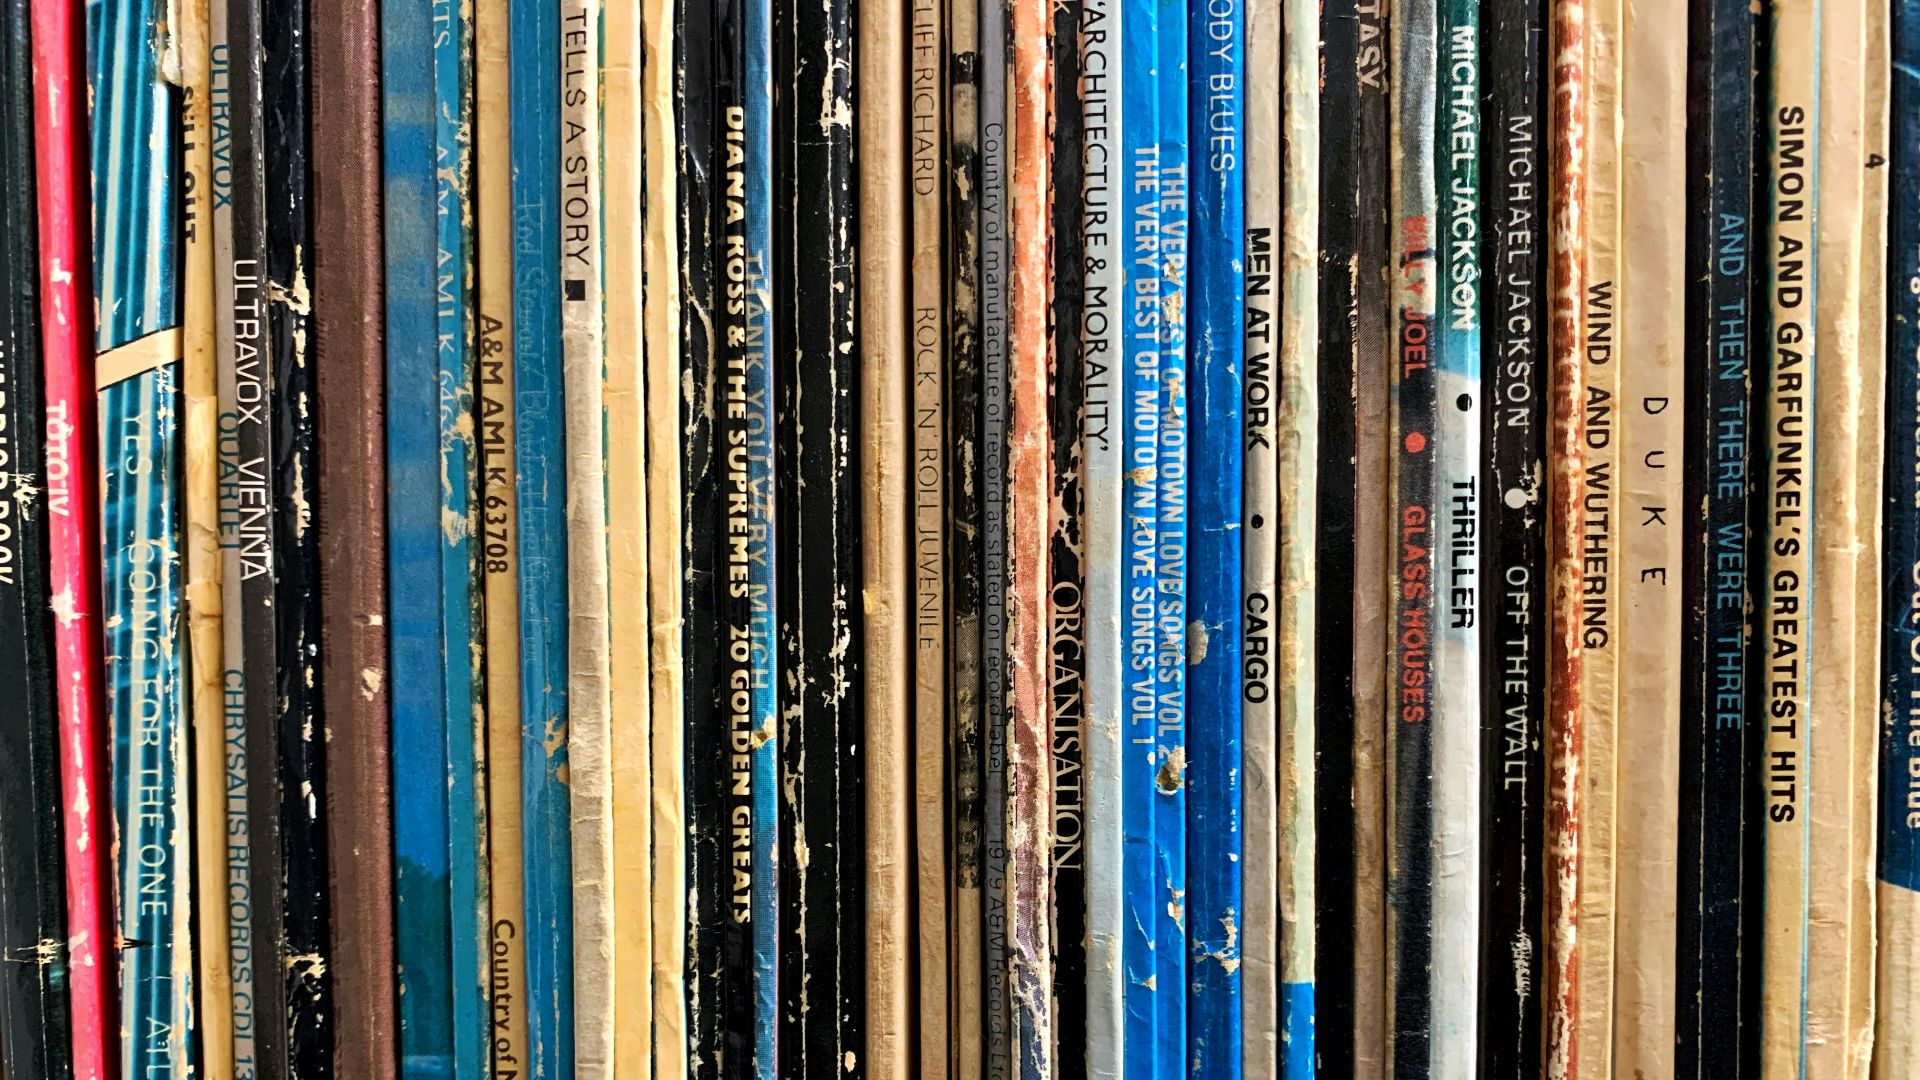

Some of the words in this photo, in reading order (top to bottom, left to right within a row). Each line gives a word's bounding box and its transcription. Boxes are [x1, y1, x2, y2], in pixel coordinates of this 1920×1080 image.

[564, 9, 587, 107] TELLS
[211, 45, 233, 211] ULTRAVOX
[566, 121, 587, 145] A
[914, 68, 935, 197] RICHARD
[1210, 75, 1235, 172] BLUES
[1451, 25, 1476, 172] MICHAEL
[437, 144, 450, 216] AM
[726, 106, 744, 225] DIANA
[983, 123, 1003, 212] Country
[1134, 143, 1160, 195] THE
[1160, 163, 1186, 214] THE
[1507, 115, 1532, 265] MICHAEL
[1778, 106, 1804, 222] SIMON
[1865, 154, 1886, 169] 4
[566, 156, 588, 265] STORY
[987, 223, 1004, 243] of
[1134, 200, 1160, 271] VERY
[727, 236, 745, 315] ROSS
[1085, 256, 1107, 276] &
[1160, 219, 1185, 287] VERY
[1246, 228, 1271, 296] MEN
[1402, 215, 1427, 295] BILLY
[1451, 178, 1476, 331] JACKSON
[1777, 235, 1803, 309] AND
[233, 259, 262, 425] ULTRAVOX
[480, 314, 504, 385] A&M
[727, 326, 746, 348] &
[745, 250, 768, 371] THANK
[916, 307, 938, 387] ROCK
[986, 251, 1004, 394] manufacture
[1134, 277, 1160, 344] BEST
[1248, 307, 1270, 345] AT
[1404, 306, 1427, 379] JOEL
[1506, 273, 1531, 427] JACKSON
[1586, 281, 1611, 365] WIND
[1719, 298, 1744, 381] THEN
[728, 354, 746, 421] THE
[1134, 351, 1159, 382] OF
[1246, 352, 1270, 451] WORK
[46, 400, 68, 481] TOTO
[124, 410, 151, 475] YES
[483, 397, 507, 486] AMLK
[747, 388, 767, 462] YOU
[988, 404, 1004, 425] of
[1133, 390, 1159, 508] MOTOWN
[1586, 385, 1610, 450] AND
[1717, 399, 1743, 499] THERE
[1773, 323, 1803, 557] GARFUNKEL'S
[918, 448, 938, 517] ROLL
[988, 433, 1005, 504] record
[1160, 408, 1185, 523] MOTOWN
[237, 457, 266, 582] VIENNA
[484, 495, 508, 574] 63708
[727, 430, 749, 598] SUPREMES
[988, 511, 1001, 534] as
[1133, 516, 1157, 579] LOVE
[1402, 505, 1426, 599] GLASS
[1451, 476, 1476, 629] THRILLER
[918, 526, 940, 650] JUVENILE
[987, 541, 1005, 606] stated
[1159, 530, 1184, 594] LOVE
[1505, 565, 1529, 626] OFF
[1582, 463, 1610, 649] WUTHERING
[1716, 523, 1743, 610] WERE
[128, 541, 159, 660] GOING
[750, 585, 769, 689] MUCH
[988, 614, 1002, 640] on
[1132, 586, 1156, 671] SONGS
[730, 624, 750, 663] 20
[988, 648, 1005, 716] record
[1157, 600, 1184, 684] SONGS
[1245, 592, 1269, 704] CARGO
[1401, 608, 1426, 723] HOUSES
[1504, 639, 1529, 695] THE
[1770, 570, 1800, 738] GREATEST
[134, 679, 160, 745] FOR
[730, 669, 751, 796] GOLDEN
[1052, 581, 1081, 871] ORGANISATION
[1132, 676, 1157, 726] VOL
[1132, 735, 1156, 745] 1
[1158, 690, 1183, 737] VOL
[224, 669, 248, 835] CHRYSALIS
[1504, 705, 1529, 790] WALL
[1770, 751, 1796, 823] HITS
[136, 762, 164, 830] THE
[140, 844, 166, 915] ONE
[732, 806, 752, 923] GREATS
[988, 837, 1006, 889] 1979
[227, 846, 251, 983] RECORDS
[990, 897, 1006, 953] A&M
[494, 919, 516, 1031] Country
[496, 1037, 518, 1064] of
